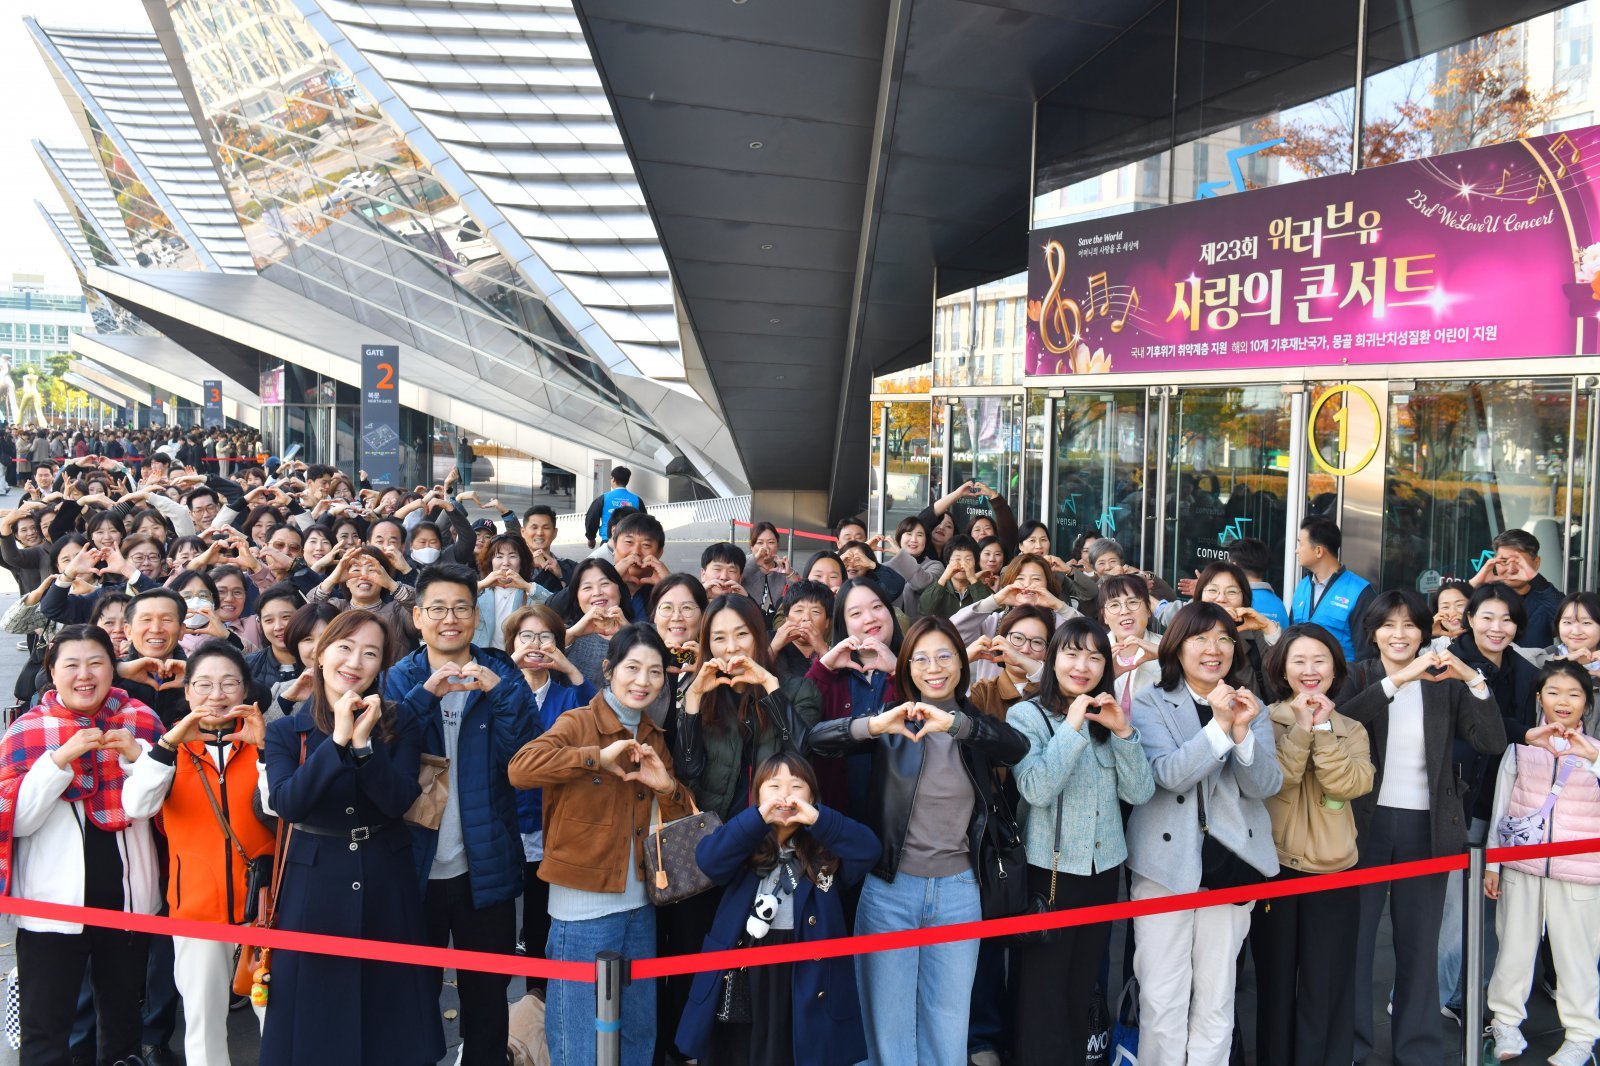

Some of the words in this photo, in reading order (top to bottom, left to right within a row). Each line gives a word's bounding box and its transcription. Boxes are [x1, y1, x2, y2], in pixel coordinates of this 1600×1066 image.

[1406, 189, 1439, 218] 23rd
[1438, 206, 1501, 233] WeLoveU
[1503, 208, 1555, 232] Concert
[1078, 238, 1093, 247] Save
[1092, 235, 1103, 244] the
[1103, 231, 1124, 243] World
[1199, 236, 1259, 265] 제23회
[1267, 201, 1383, 258] 위러브유
[1165, 268, 1283, 331] 사랑의
[1293, 253, 1438, 323] 콘서트
[1131, 347, 1145, 359] 국내
[1146, 345, 1176, 358] 기후위기
[1177, 342, 1209, 357] 취약계층
[1211, 341, 1227, 355] 지원
[1231, 340, 1248, 354] 해외
[1250, 339, 1269, 353] 10개
[1271, 335, 1330, 352] 기후재난국가,
[1332, 334, 1353, 349] 몽골
[1355, 329, 1431, 348] 희귀난치성질환
[1434, 326, 1469, 343] 어린이
[1472, 324, 1498, 341] 지원
[210, 387, 221, 402] 3
[376, 362, 394, 389] 2
[1332, 407, 1348, 452] 1
